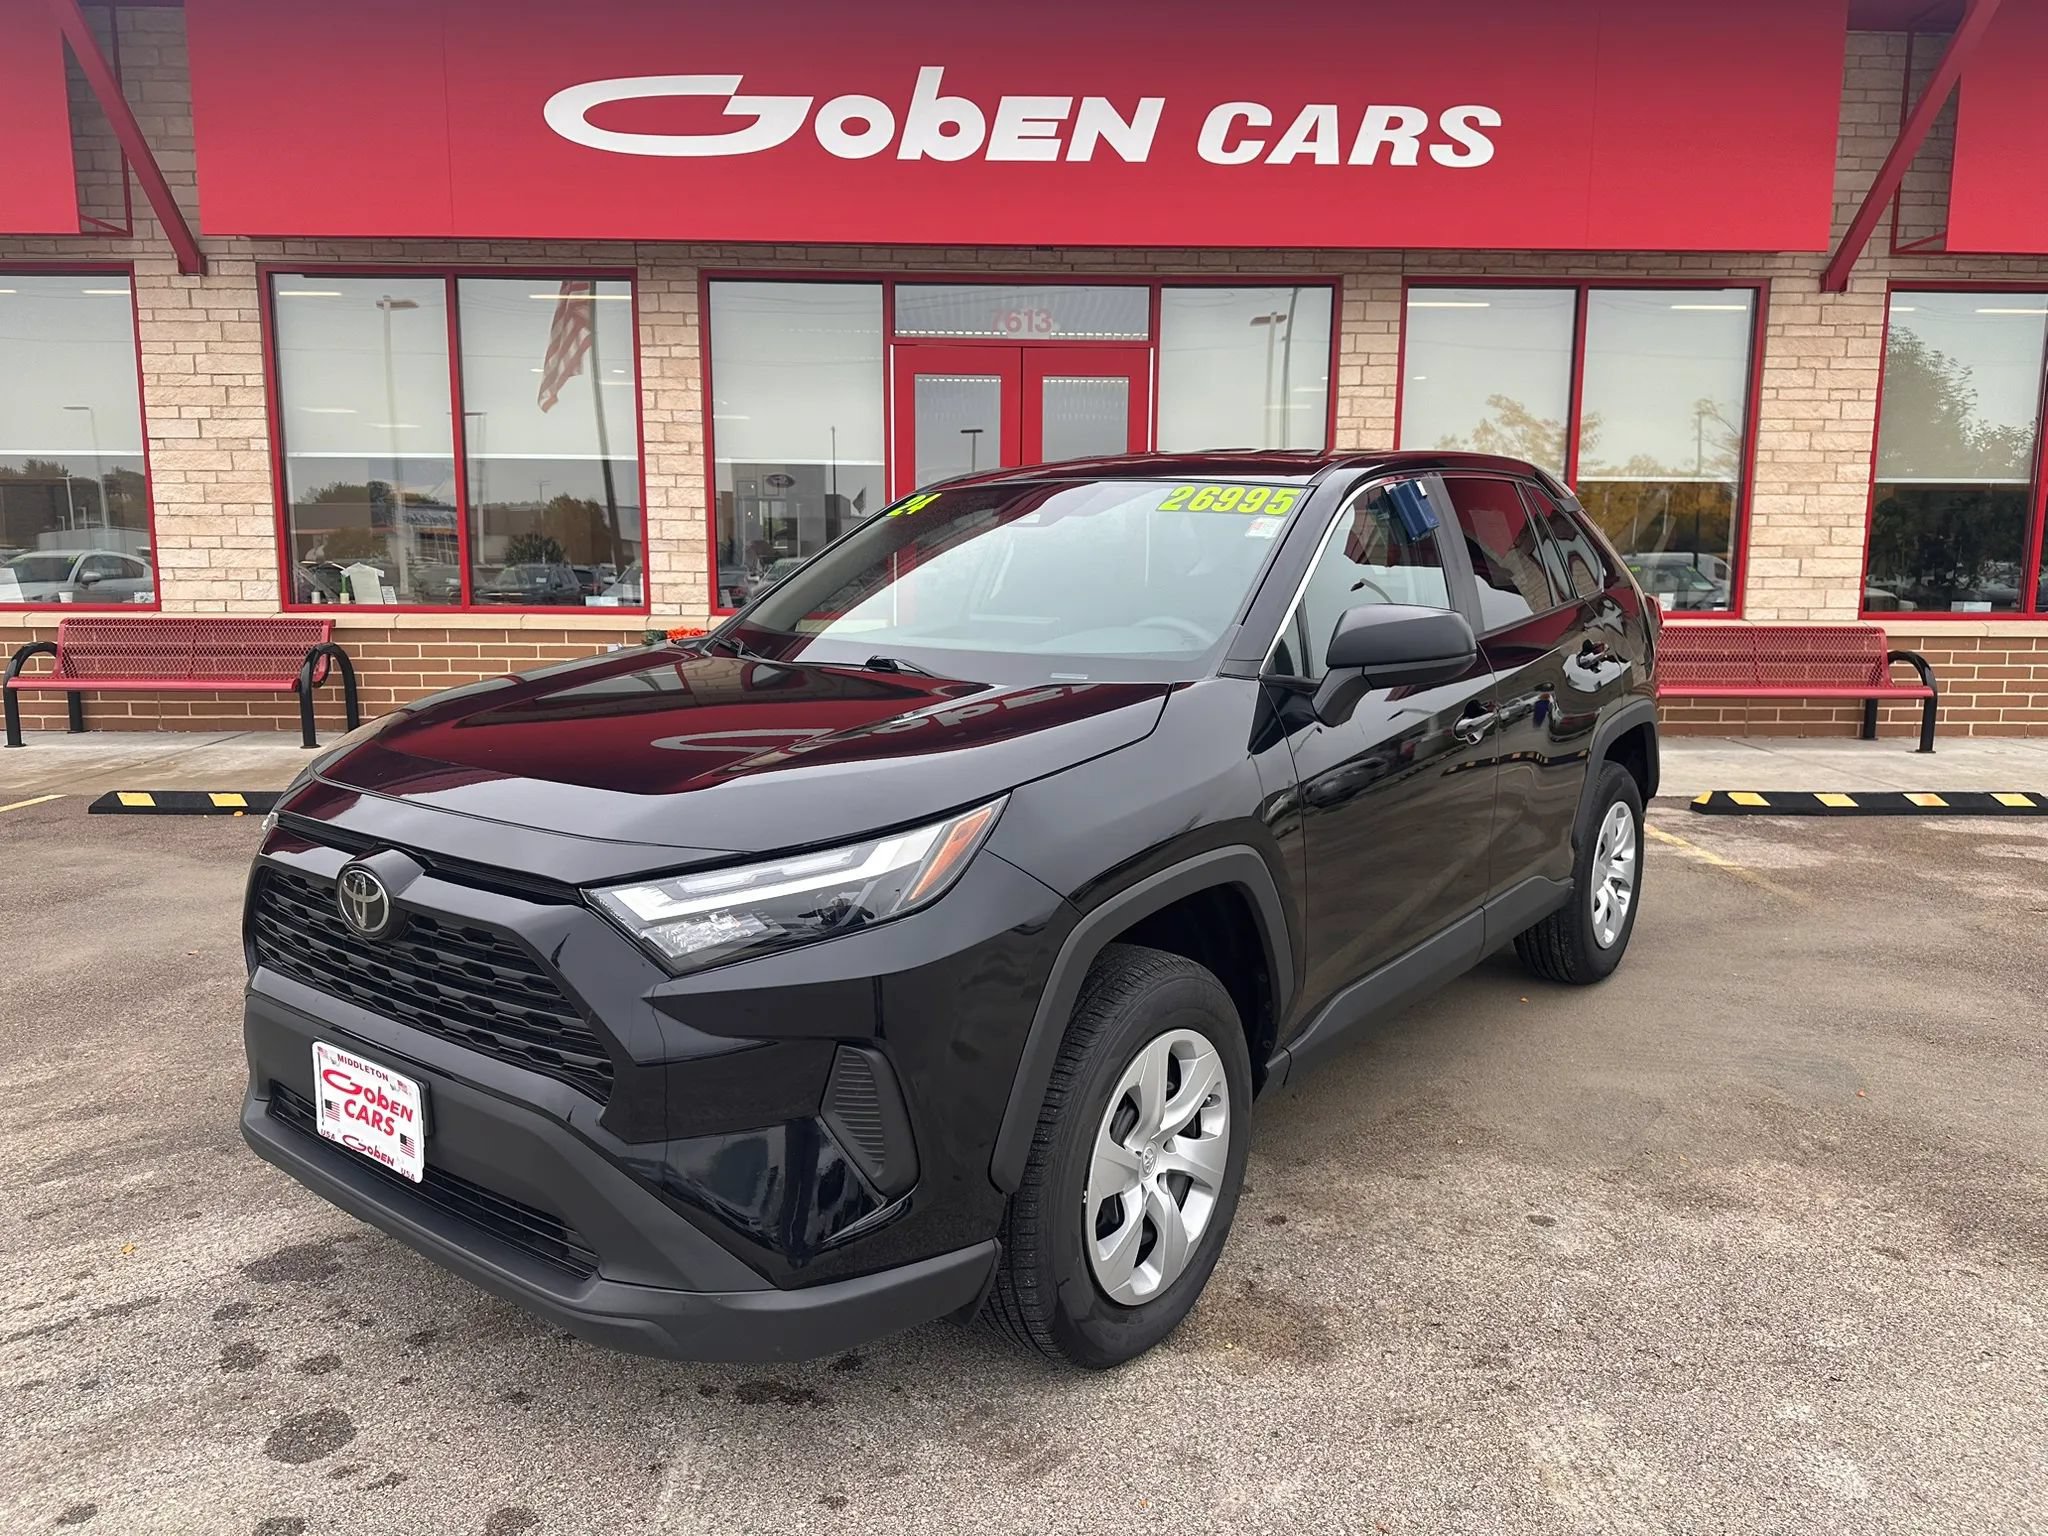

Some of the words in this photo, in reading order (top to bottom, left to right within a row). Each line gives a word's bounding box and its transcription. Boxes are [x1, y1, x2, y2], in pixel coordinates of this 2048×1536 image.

[1197, 101, 1502, 168] CARS
[990, 308, 1053, 333] 7613
[886, 493, 942, 517] 24
[1158, 485, 1301, 515] 26995
[337, 1053, 389, 1082] MIDDLETON
[344, 1099, 395, 1137] CARS
[320, 1129, 336, 1141] USA
[400, 1167, 415, 1181] USA
